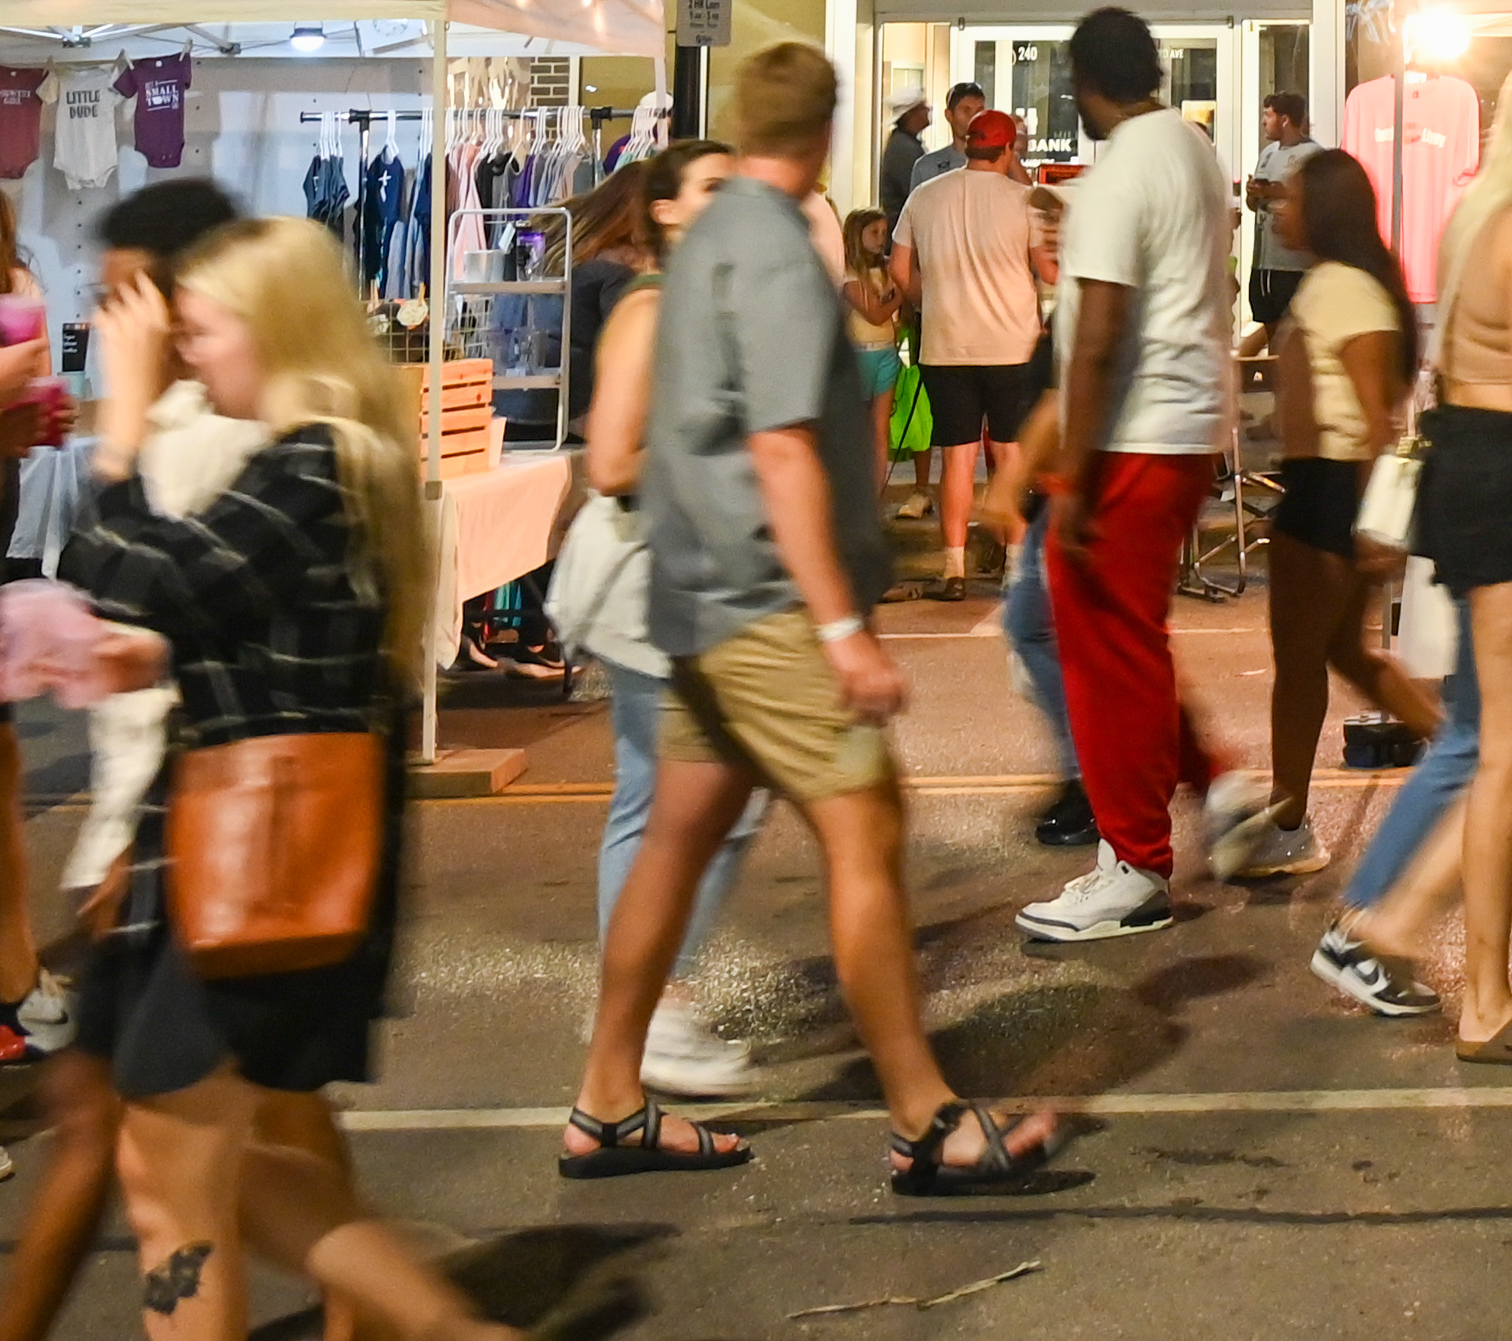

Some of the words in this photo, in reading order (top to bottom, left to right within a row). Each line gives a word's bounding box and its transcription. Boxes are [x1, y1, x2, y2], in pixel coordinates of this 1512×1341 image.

[1018, 46, 1038, 61] 240
[1170, 48, 1184, 59] AVE
[66, 90, 101, 105] LITTLE
[69, 105, 98, 119] DUDE
[1028, 138, 1072, 152] BANK
